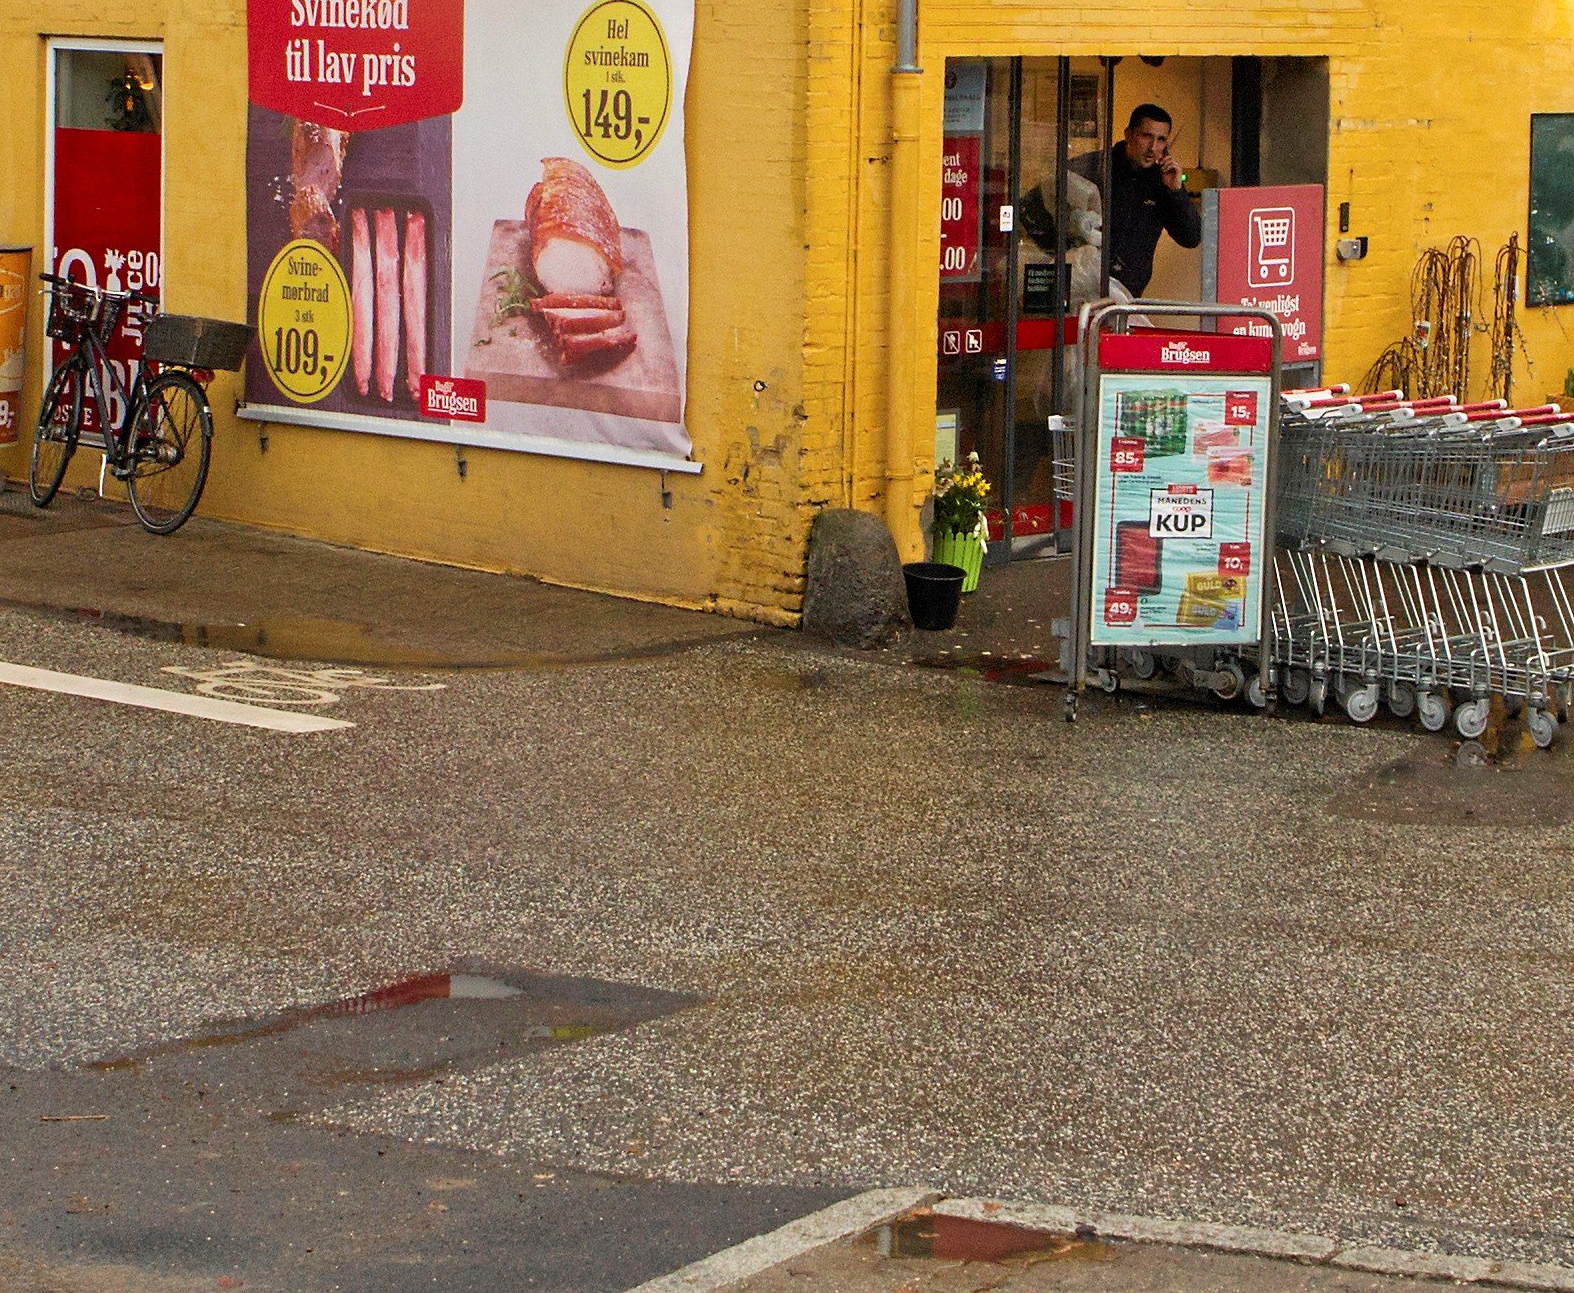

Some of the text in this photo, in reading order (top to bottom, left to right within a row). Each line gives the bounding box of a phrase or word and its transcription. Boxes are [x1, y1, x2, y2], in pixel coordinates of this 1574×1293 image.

[607, 19, 629, 39] Hel
[584, 46, 649, 67] svinekam
[286, 39, 416, 96] til lav pris
[582, 88, 650, 150] 149,-
[944, 169, 968, 185] dage
[288, 256, 323, 277] Svine-
[282, 282, 329, 302] mørbrad
[274, 327, 334, 385] 109,-
[1161, 347, 1211, 364] Brugsen
[427, 388, 478, 416] Brugsen
[1156, 514, 1207, 532] KUP
